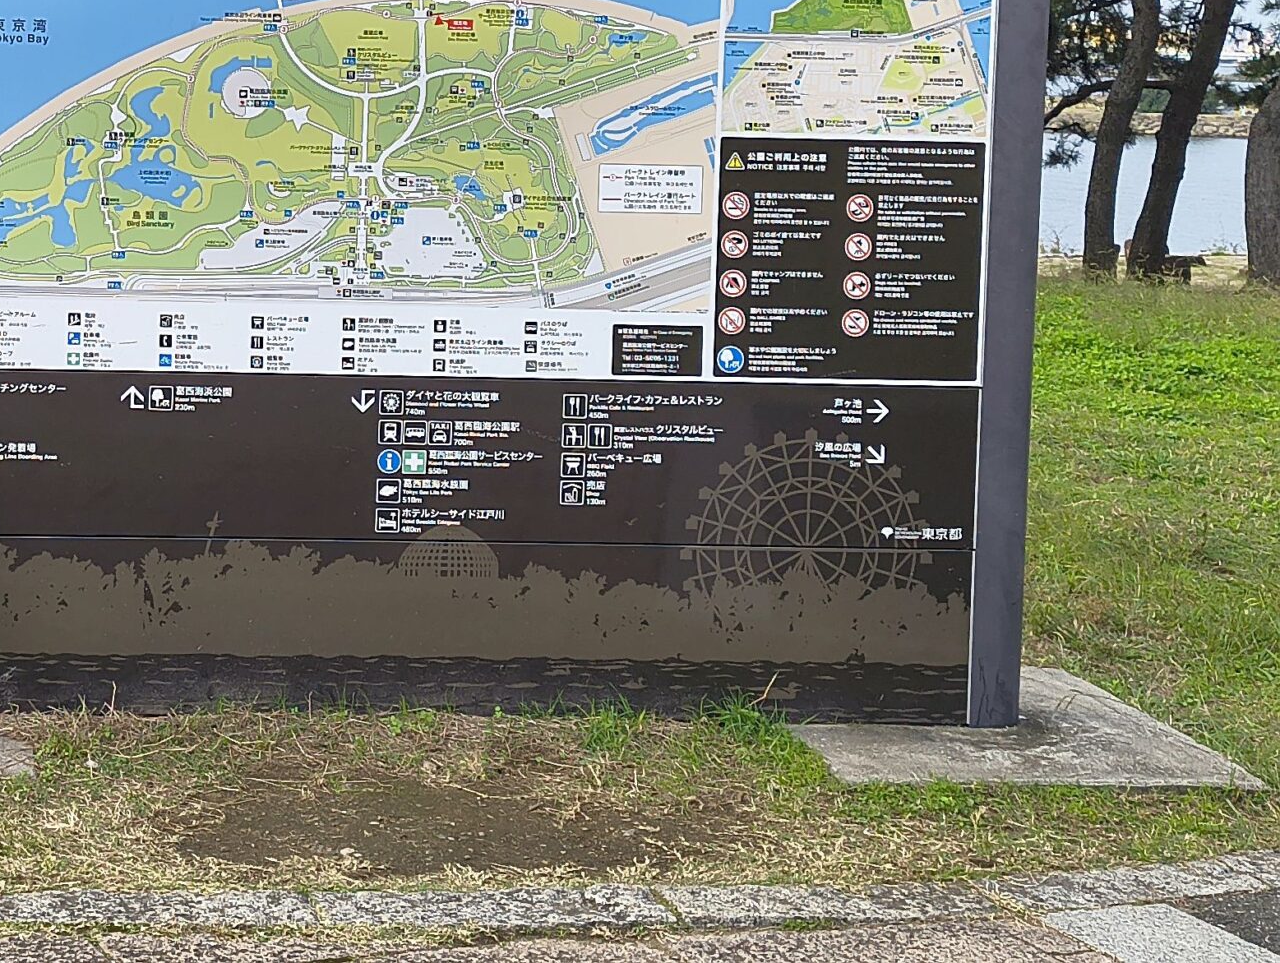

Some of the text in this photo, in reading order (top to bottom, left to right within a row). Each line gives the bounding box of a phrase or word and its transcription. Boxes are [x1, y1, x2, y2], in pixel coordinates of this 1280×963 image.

[27, 33, 50, 46] Bay
[141, 221, 175, 229] Sanctuary
[176, 385, 233, 397] 葛西海浜公園
[406, 390, 500, 402] ダイヤと花の大観覧車
[589, 394, 723, 406] パークライフ・カフェ&レストラン
[454, 421, 521, 432] 葛西臨海公園駅
[656, 424, 724, 436] クリスタルビュー
[454, 438, 474, 446] 700m
[429, 449, 543, 462] 葛西臨海公園サービスセンター
[587, 453, 663, 465] バーベキュー広場
[403, 478, 469, 490] 葛西臨海水族園
[402, 508, 506, 520] ホテルシーサイド江戸川
[922, 527, 963, 541] 東京都
